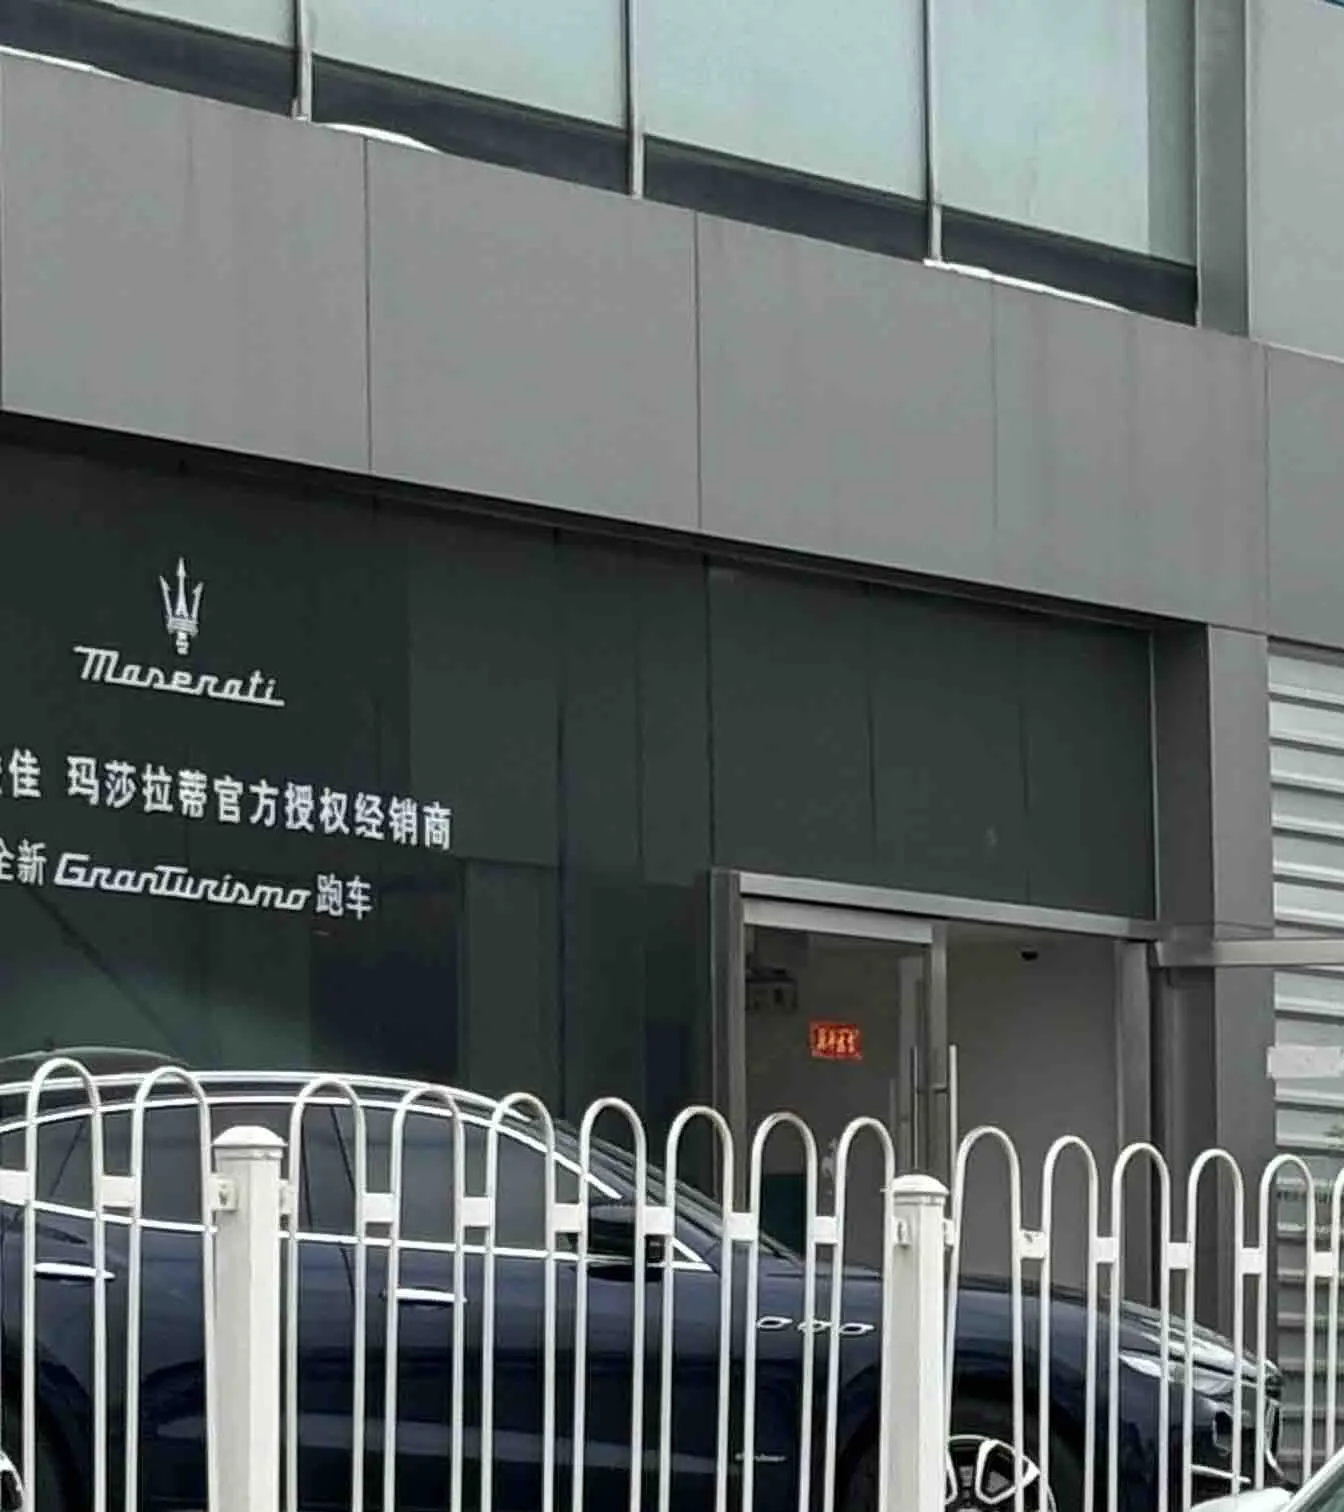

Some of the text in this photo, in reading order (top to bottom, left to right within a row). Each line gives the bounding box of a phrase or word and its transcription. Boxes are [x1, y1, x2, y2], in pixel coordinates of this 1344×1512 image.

[73, 645, 286, 707] Maserati
[0, 748, 452, 850] 佳 玛莎拉蒂官方授权经销商
[54, 851, 311, 911] GranTurismo
[315, 873, 373, 921] 跑车
